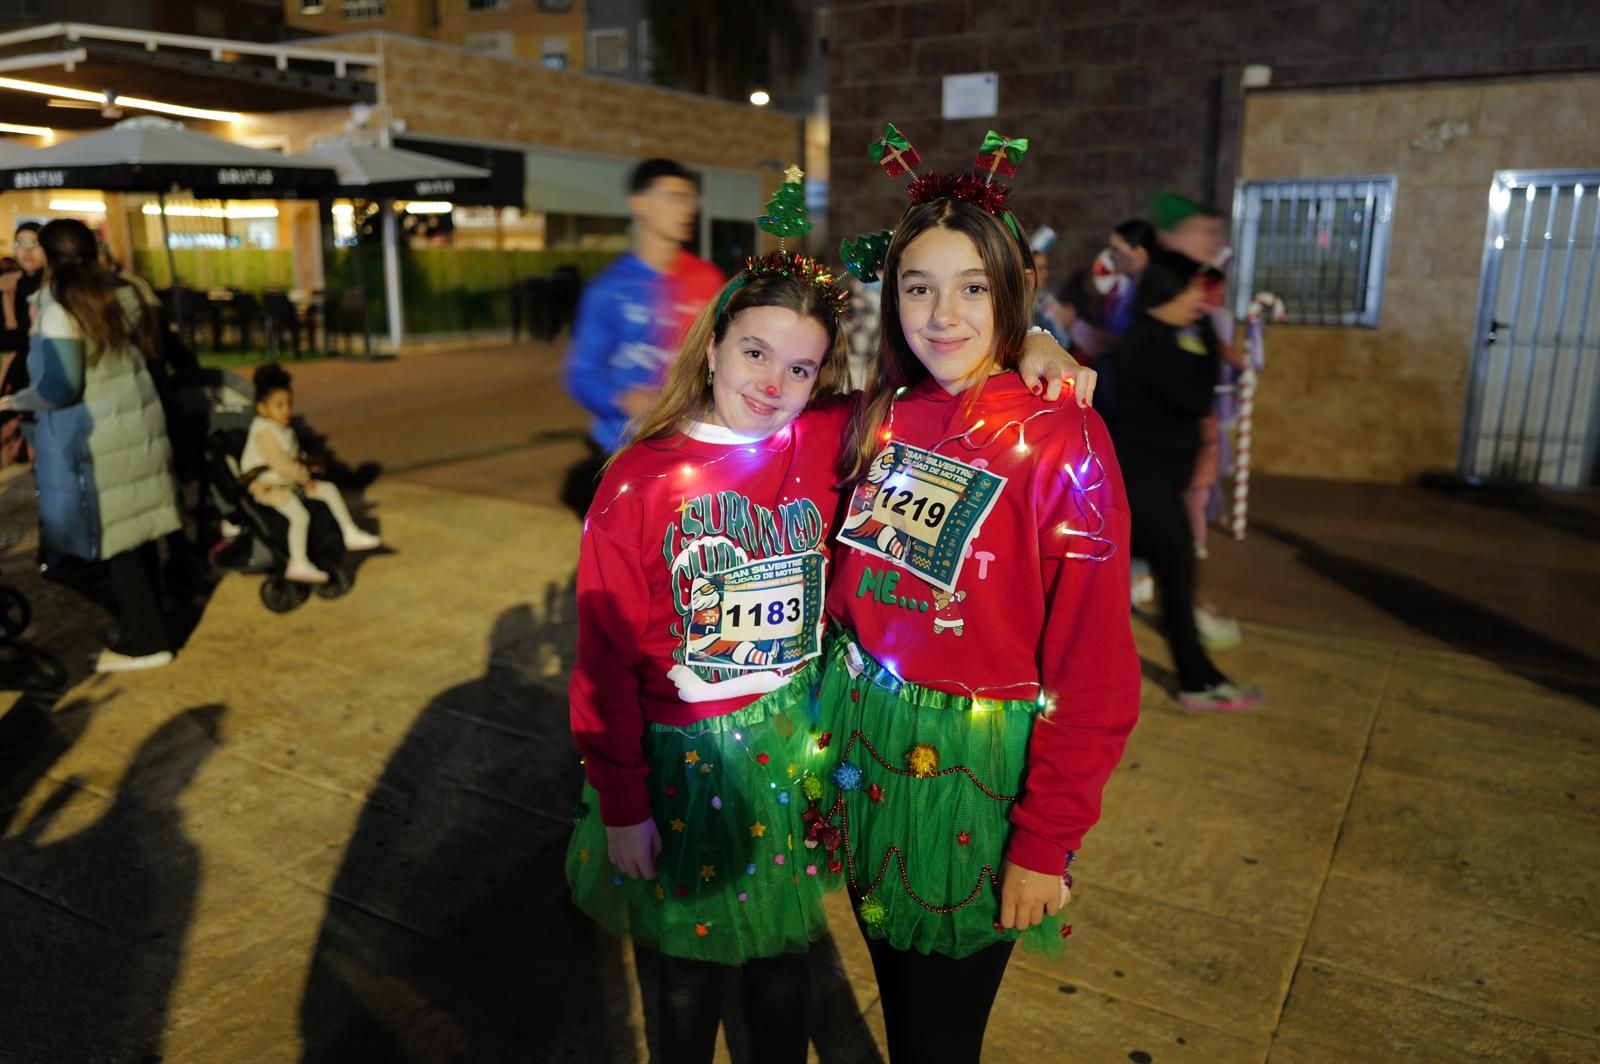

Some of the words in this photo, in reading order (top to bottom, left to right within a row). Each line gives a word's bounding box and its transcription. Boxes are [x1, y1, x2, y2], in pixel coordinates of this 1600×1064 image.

[926, 456, 975, 479] SILVESTRE
[928, 465, 941, 475] DE
[940, 471, 969, 486] MOTRIL
[881, 486, 946, 528] 1219
[681, 490, 822, 557] SURVIVED
[724, 568, 749, 580] SAN
[752, 558, 803, 573] SILVESTRE
[725, 574, 761, 585] CIUDAD
[763, 571, 775, 580] DE
[776, 567, 804, 578] MOTRIL
[726, 598, 800, 627] 1183
